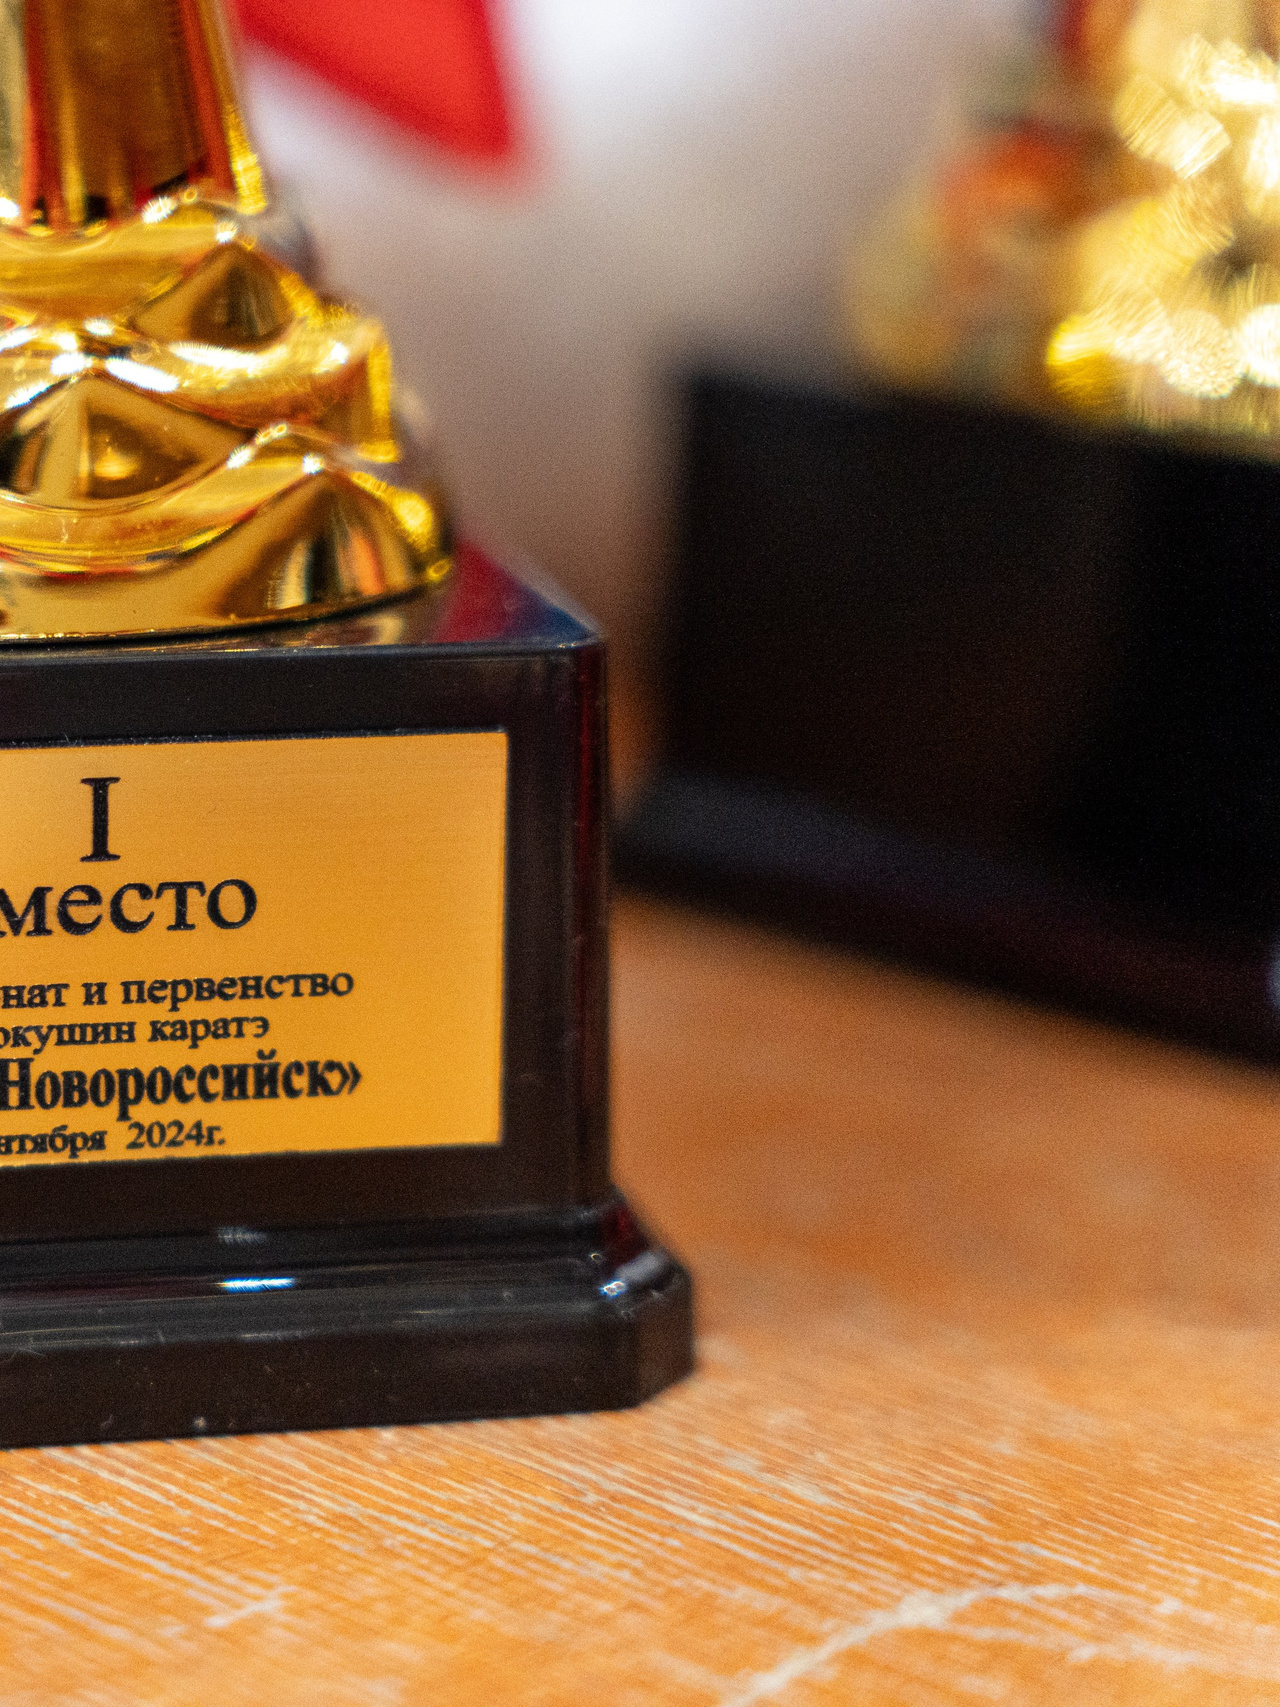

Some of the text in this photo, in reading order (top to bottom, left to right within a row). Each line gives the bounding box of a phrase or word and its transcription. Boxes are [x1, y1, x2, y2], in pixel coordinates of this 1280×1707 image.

[78, 775, 123, 863] I
[81, 981, 108, 1006] и
[120, 972, 355, 1012] первенство
[147, 1016, 271, 1049] каратэ
[125, 1119, 227, 1149] 2024г.
